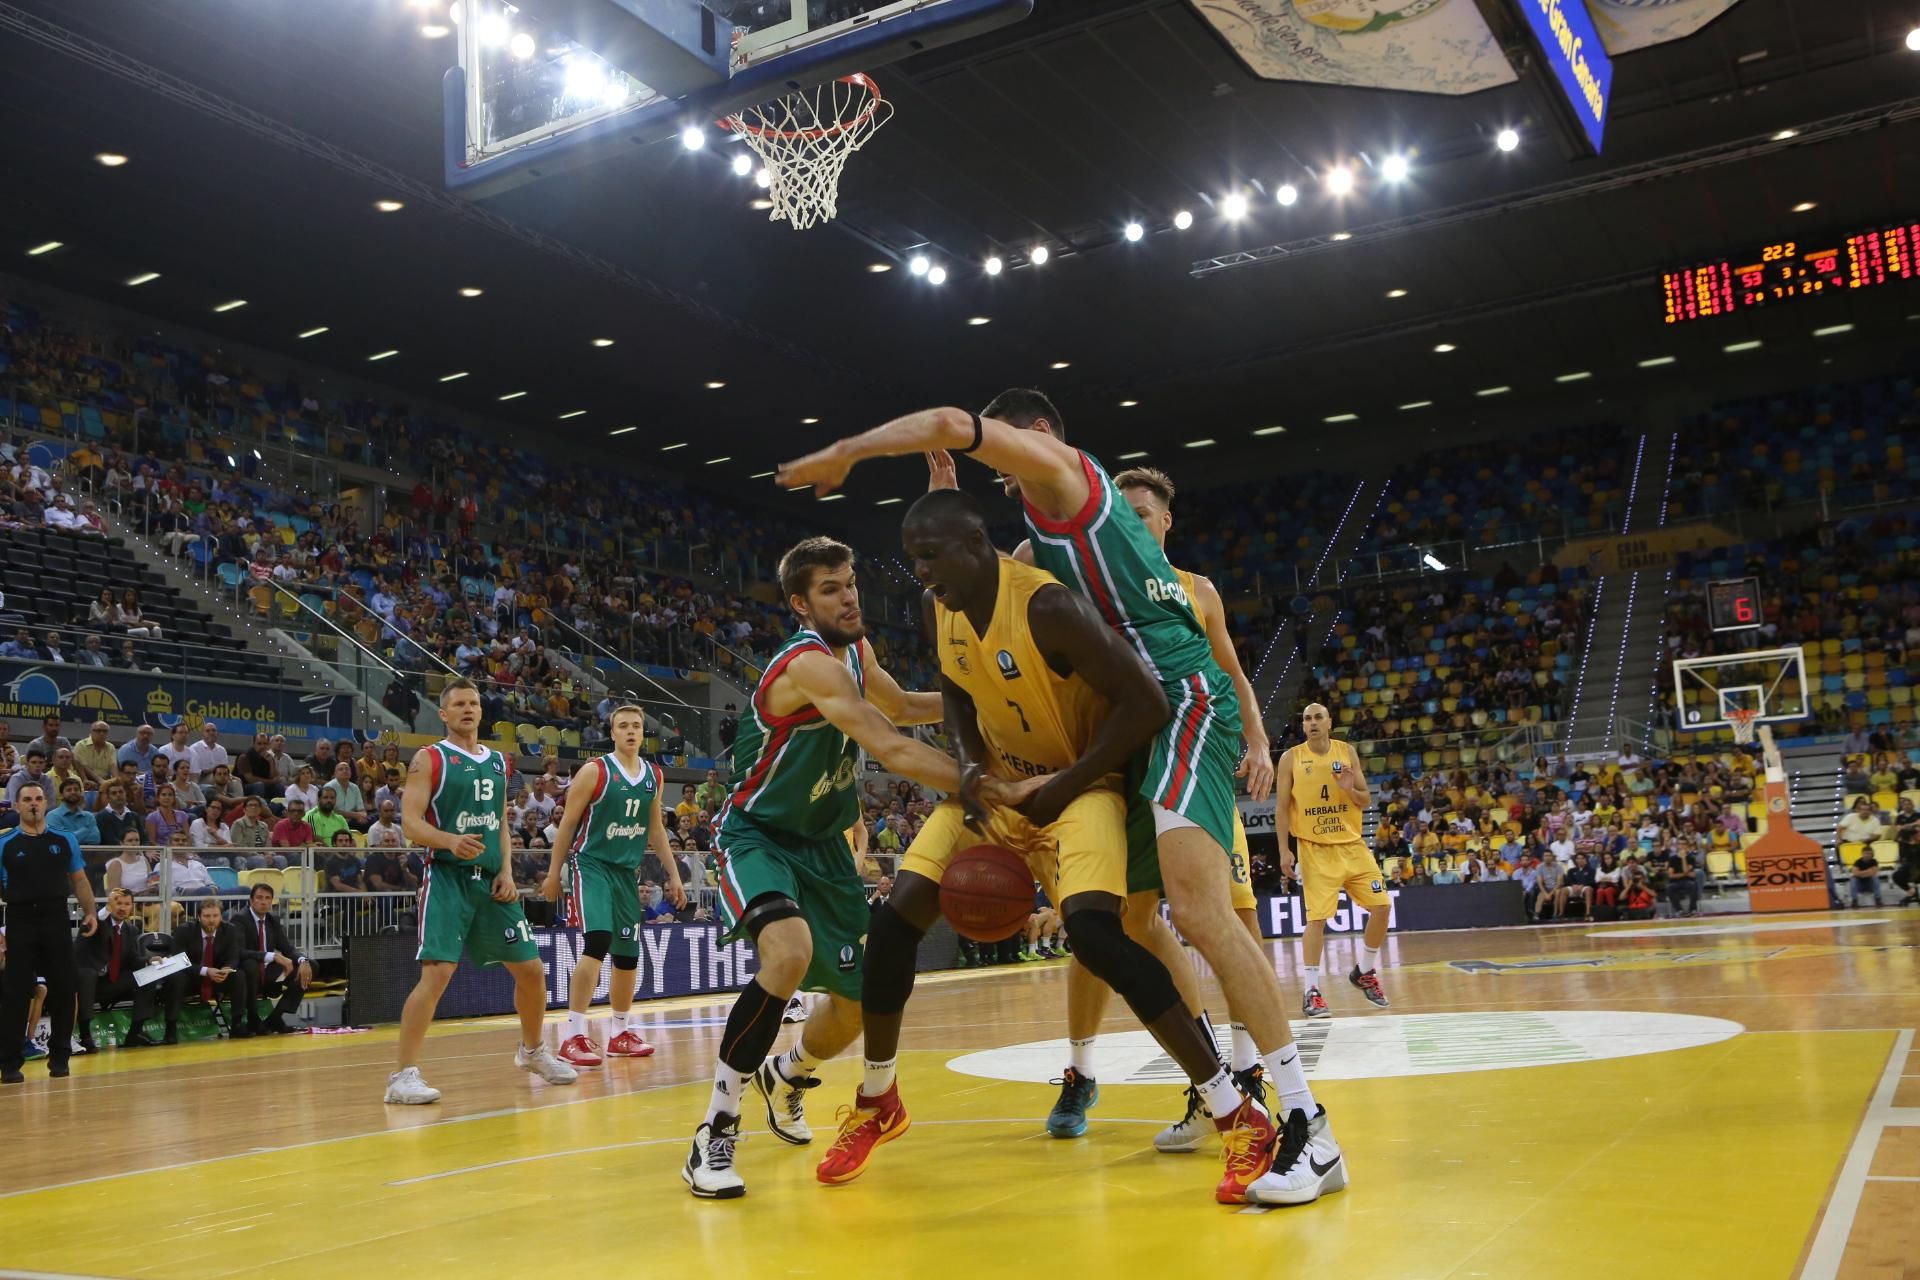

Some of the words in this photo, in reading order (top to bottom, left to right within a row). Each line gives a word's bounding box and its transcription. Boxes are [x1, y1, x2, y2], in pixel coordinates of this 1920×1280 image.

[1548, 0, 1573, 61] Gran
[1571, 36, 1604, 123] Canaria
[1741, 271, 1763, 289] 53
[1617, 539, 1648, 557] GRAN
[1618, 550, 1668, 570] CANARIA
[1735, 597, 1754, 622] 6
[0, 702, 18, 716] RAN
[185, 699, 252, 721] Cabildo
[255, 704, 276, 722] de
[473, 778, 495, 802] 13
[1320, 784, 1330, 802] 4
[625, 798, 641, 818] 11
[1317, 815, 1342, 826] Gran
[1748, 856, 1822, 873] SPORT
[1748, 870, 1825, 887] ZONE
[683, 925, 755, 990] THE
